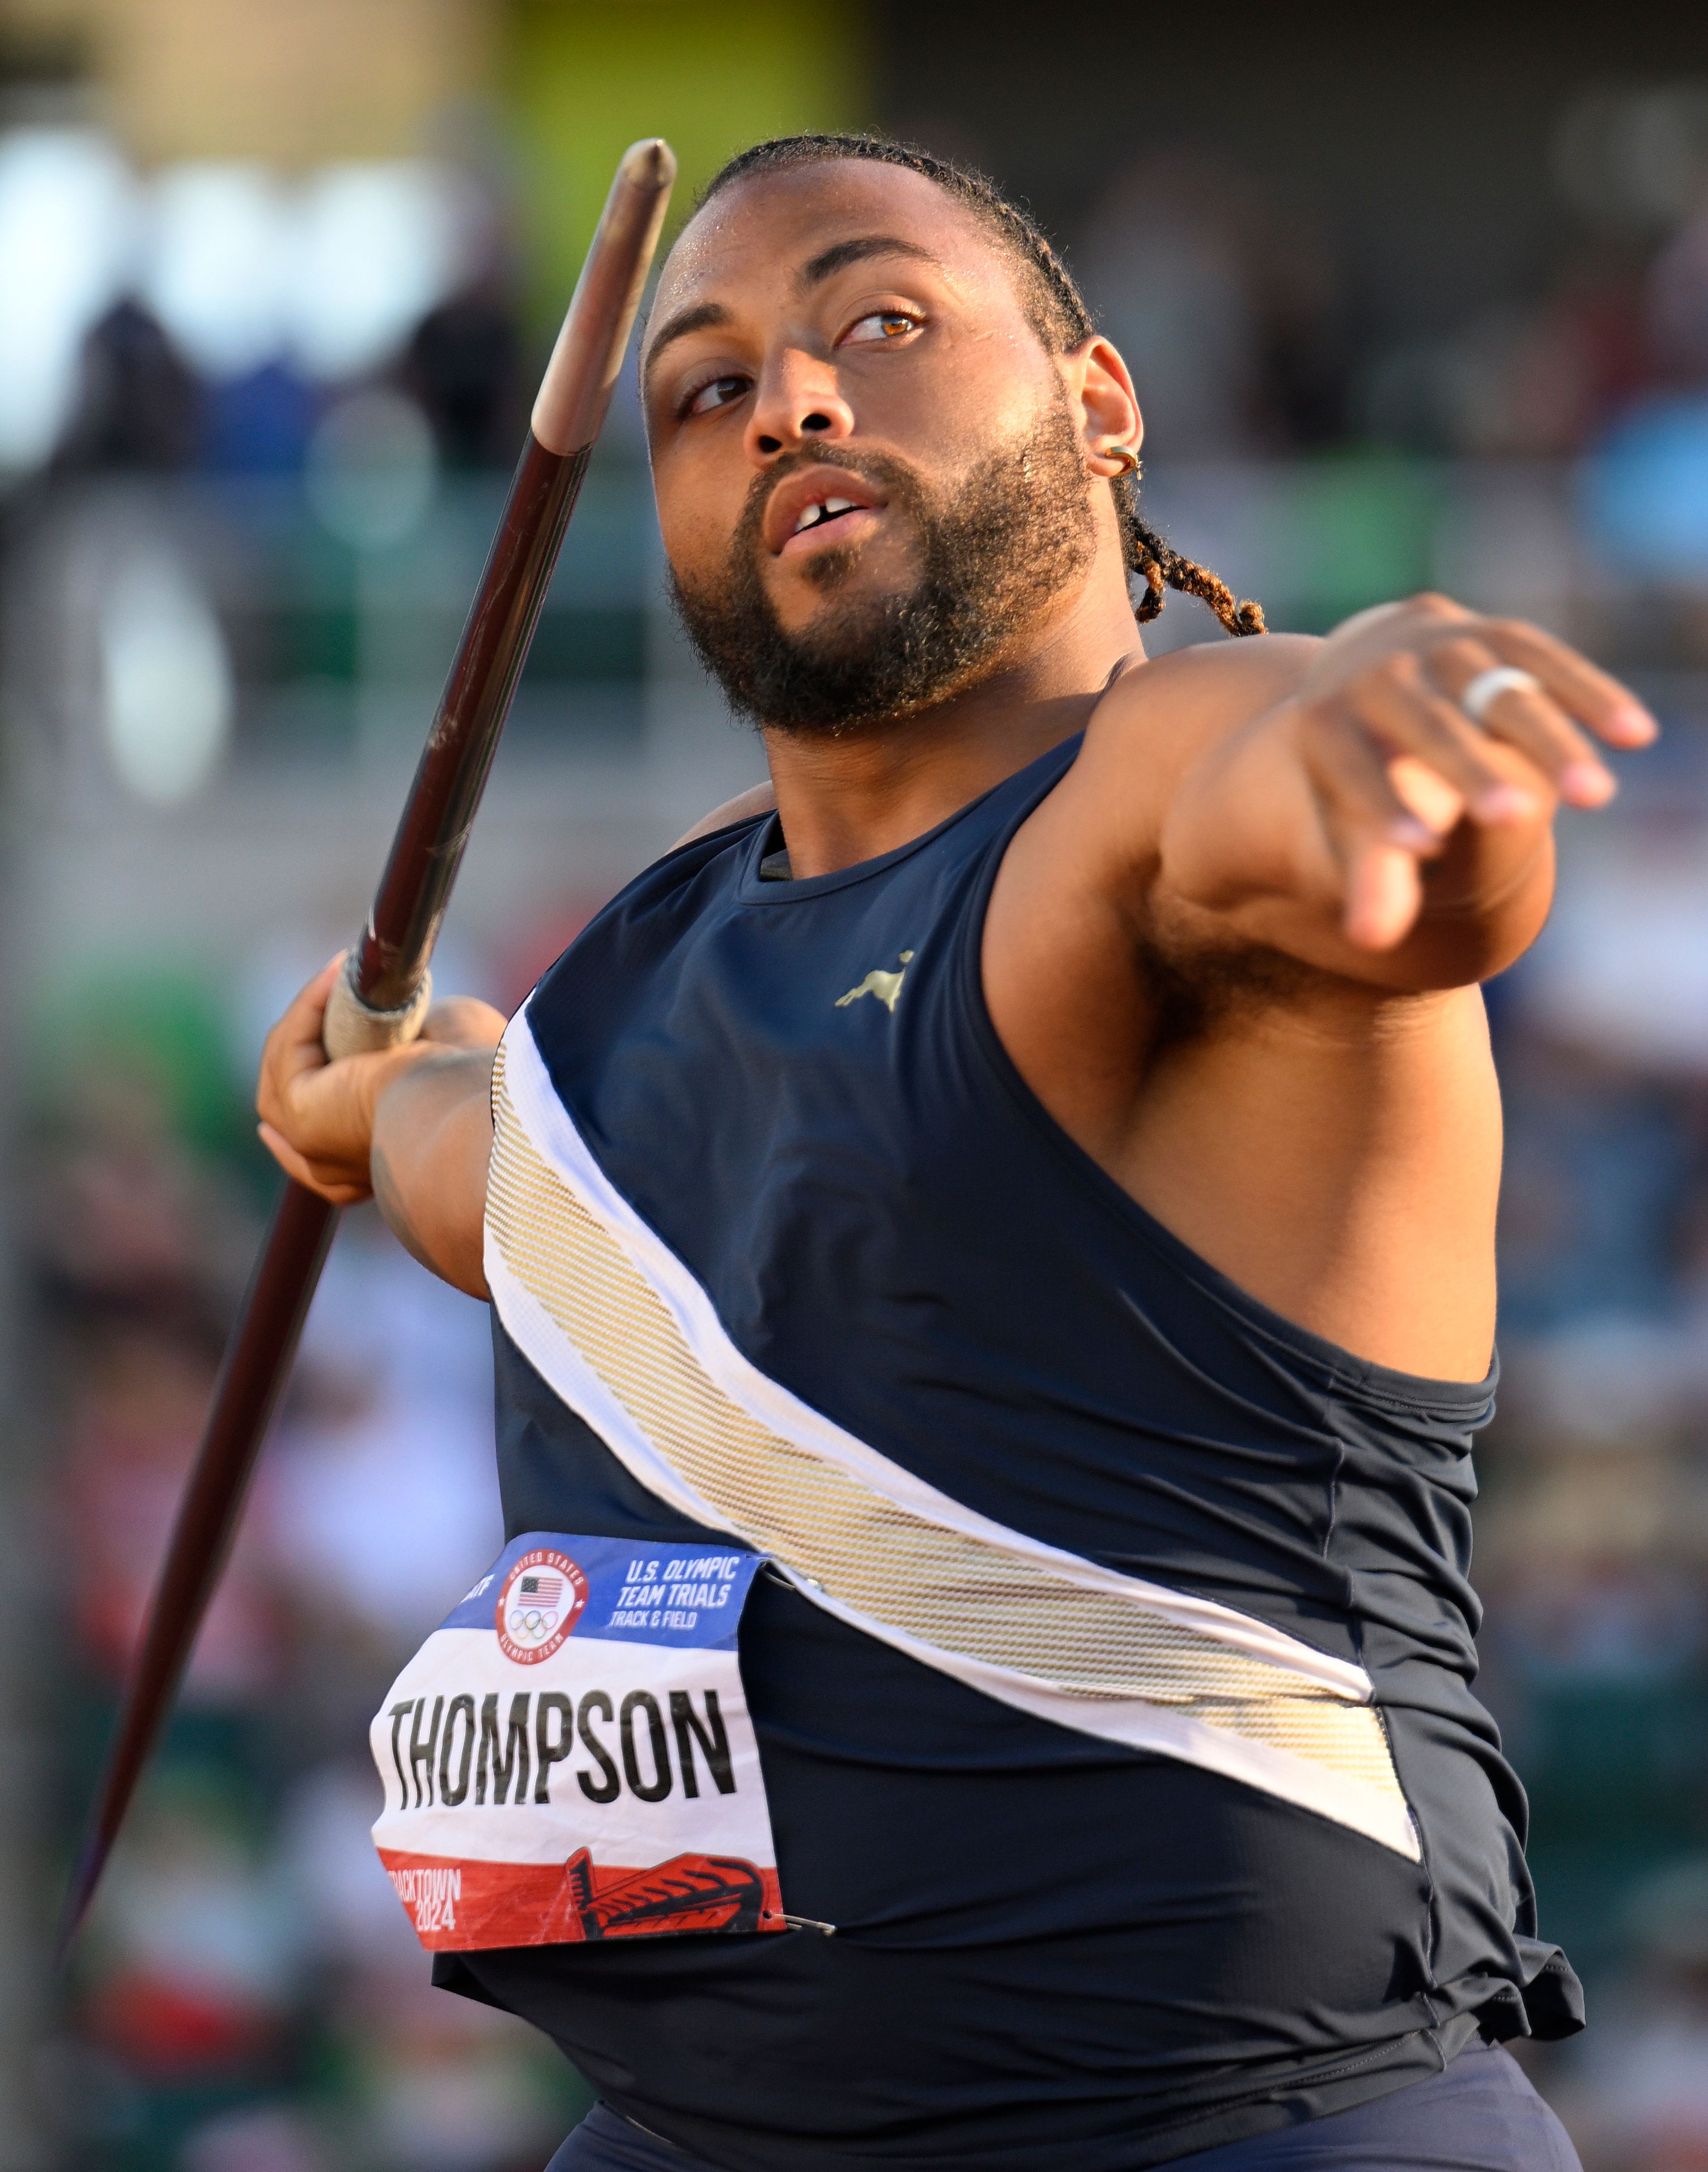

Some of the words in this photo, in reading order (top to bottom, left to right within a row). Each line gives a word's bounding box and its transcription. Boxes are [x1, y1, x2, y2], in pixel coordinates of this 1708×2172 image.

[509, 1551, 542, 1580] UNITED
[547, 1552, 584, 1585] STATES
[626, 1559, 657, 1584] U.S.
[663, 1555, 740, 1581] OLYMPIC
[616, 1585, 665, 1609] TEAM
[667, 1583, 731, 1608] TRIALS
[609, 1610, 649, 1628] TRACK
[652, 1611, 661, 1627] &
[662, 1611, 698, 1629] FIELD
[500, 1633, 534, 1661] OLYMPIC
[538, 1632, 564, 1658] TEAM
[388, 1689, 737, 1810] THOMPSON
[388, 1868, 461, 1902] RACKTOWN
[414, 1899, 456, 1931] 2024
